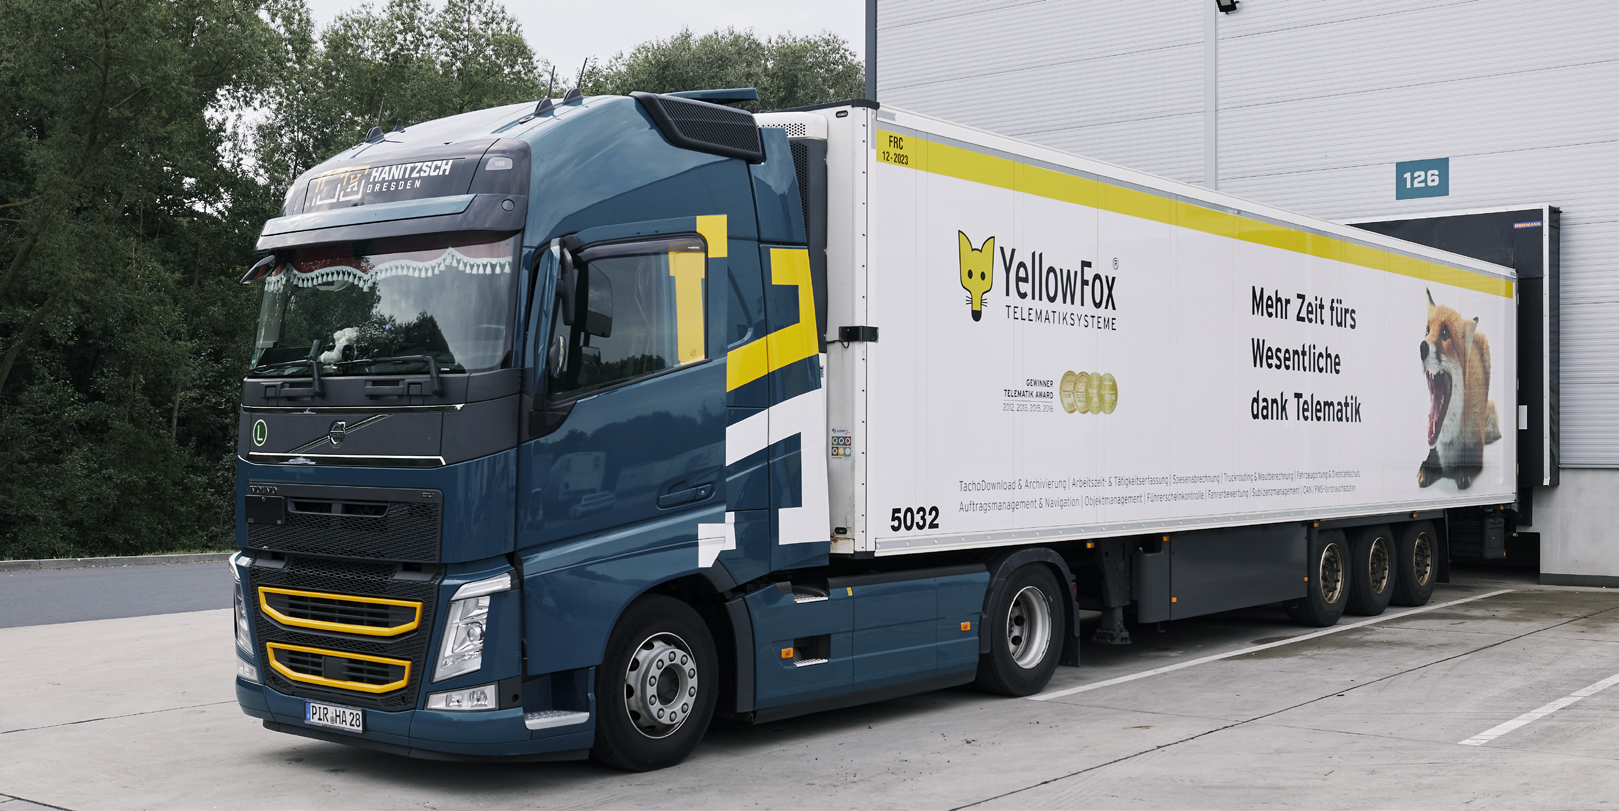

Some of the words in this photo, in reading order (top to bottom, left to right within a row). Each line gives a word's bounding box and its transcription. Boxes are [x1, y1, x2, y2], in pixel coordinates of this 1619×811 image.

[889, 135, 903, 150] FRC
[369, 160, 453, 182] HANITZSCH
[1403, 170, 1439, 188] 126
[366, 180, 422, 193] DRESDEN
[1000, 246, 1116, 311] YellowFox
[1006, 304, 1116, 330] TELEMATIKSYSTEME
[1252, 286, 1290, 320] Mehr
[1296, 293, 1324, 325] Zeit
[1330, 298, 1356, 330] fürs
[1251, 338, 1340, 374] Wesentliche
[1026, 378, 1054, 388] GEWINNER
[1004, 389, 1034, 398] TELEMATIK
[1035, 391, 1054, 399] AWARD
[1251, 390, 1288, 420] dank
[1294, 392, 1361, 422] Telematik
[257, 425, 262, 441] L
[959, 480, 1016, 492] TachoDownload
[1018, 478, 1022, 490] &
[1024, 478, 1066, 490] Archivierung
[959, 498, 1037, 514] Auftragsmanagement
[1039, 498, 1043, 508] &
[1045, 497, 1080, 510] Navigation
[1084, 494, 1142, 508] Objektmanagement
[890, 506, 940, 532] 5032
[311, 705, 329, 722] PIR
[335, 709, 347, 725] HA
[349, 712, 360, 728] 28
